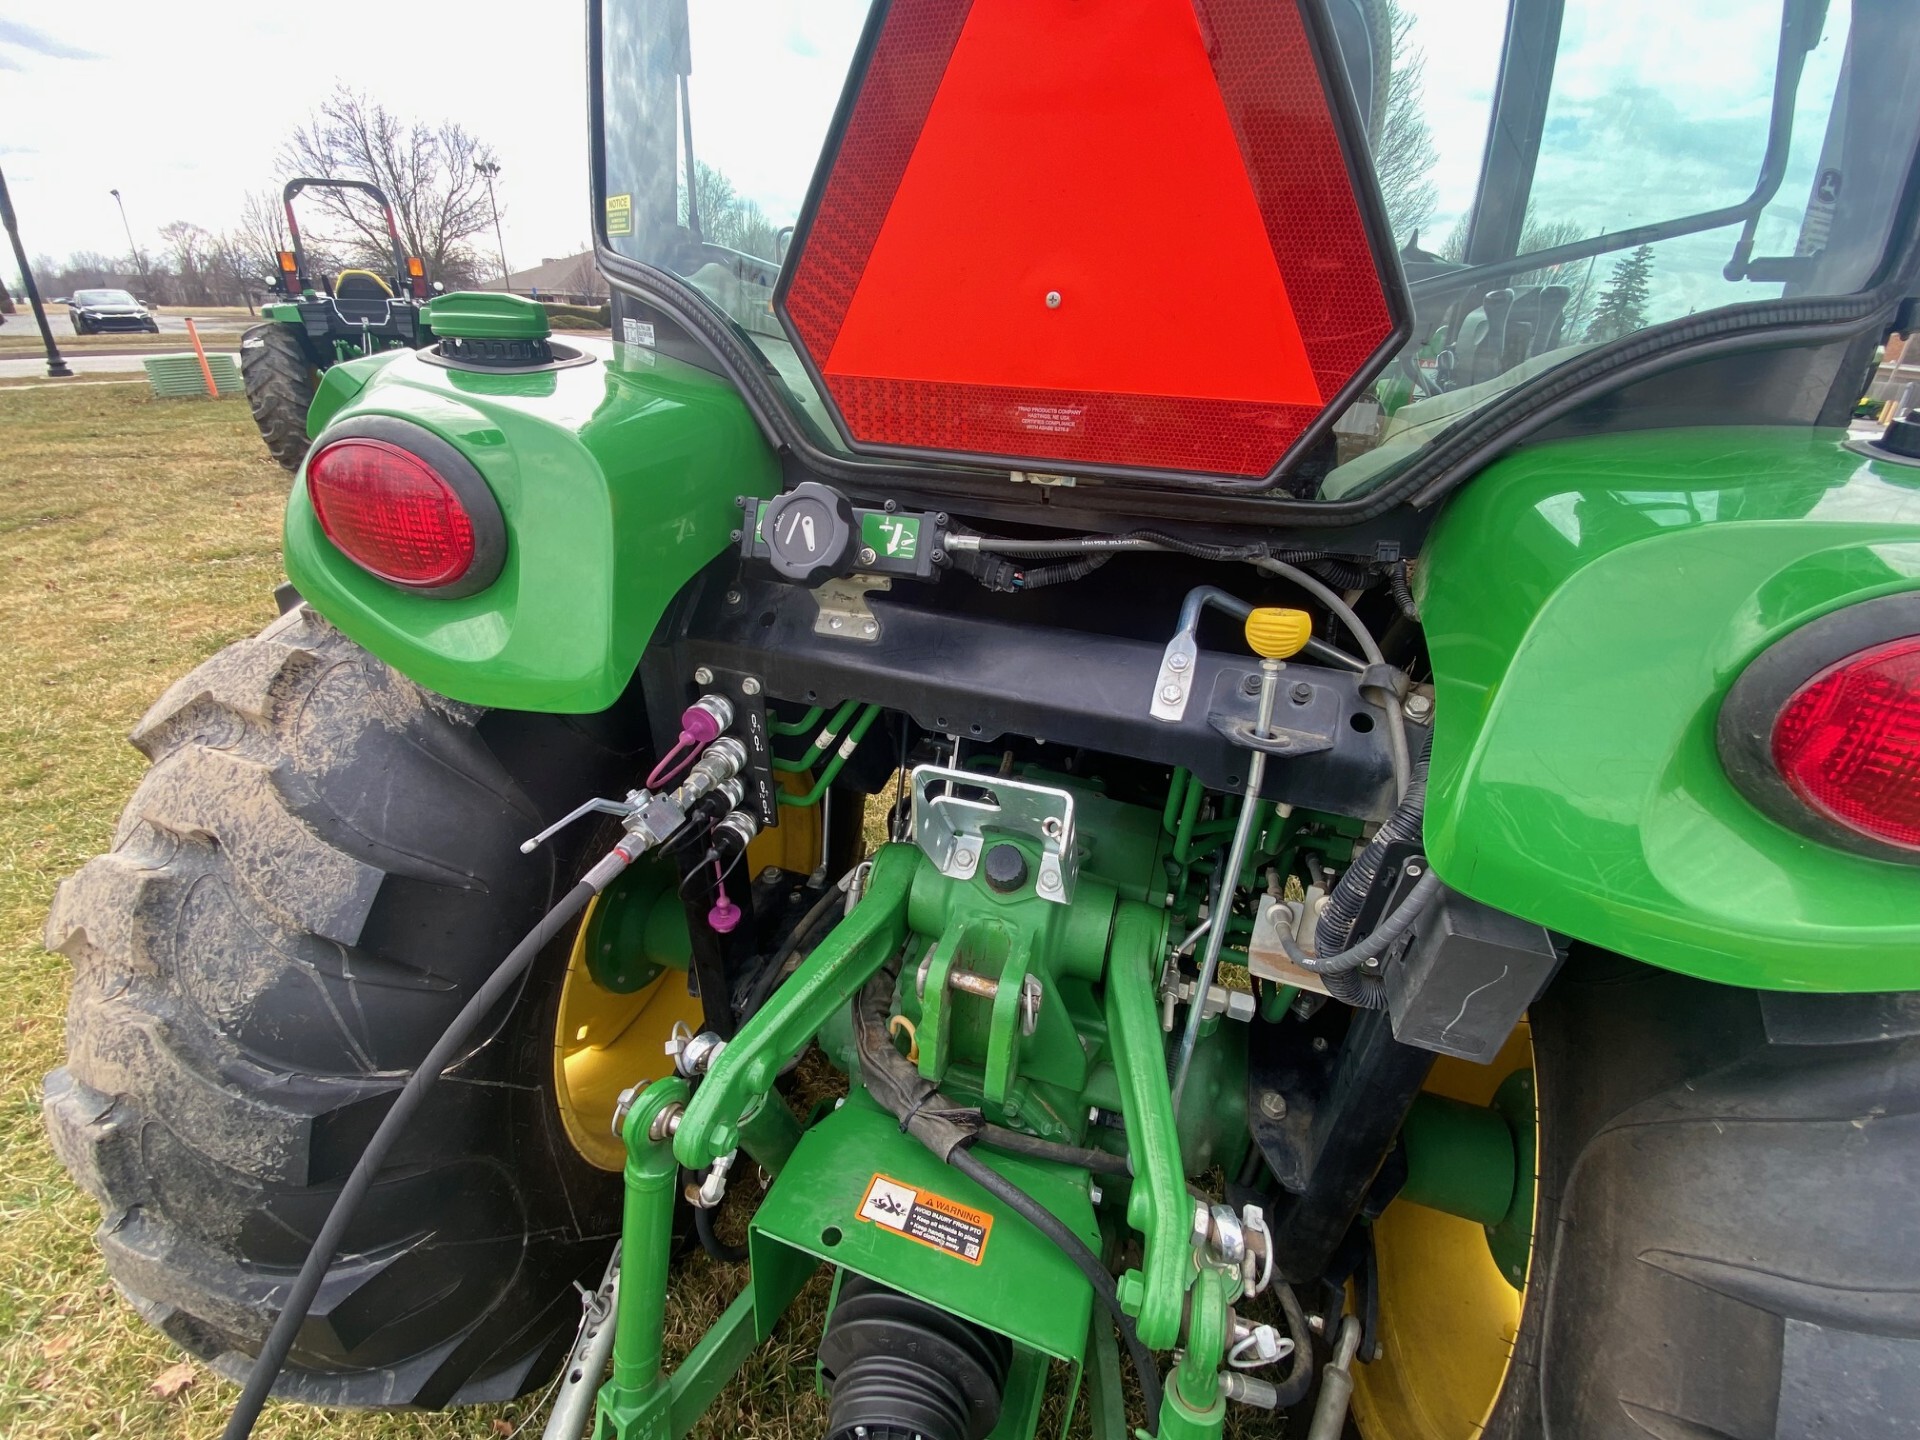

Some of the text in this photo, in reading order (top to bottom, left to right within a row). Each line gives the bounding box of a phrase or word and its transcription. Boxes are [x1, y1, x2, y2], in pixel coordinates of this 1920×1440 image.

[608, 197, 628, 209] NOTICE
[1058, 408, 1082, 416] COMPANY
[914, 1206, 982, 1235] AVOID INJURY FROM PTO
[935, 1200, 981, 1224] WARNING
[913, 1222, 928, 1232] Keep
[916, 1215, 930, 1226] Keep
[938, 1224, 957, 1235] shields
[963, 1233, 979, 1244] place
[911, 1228, 960, 1251] and clothing away
